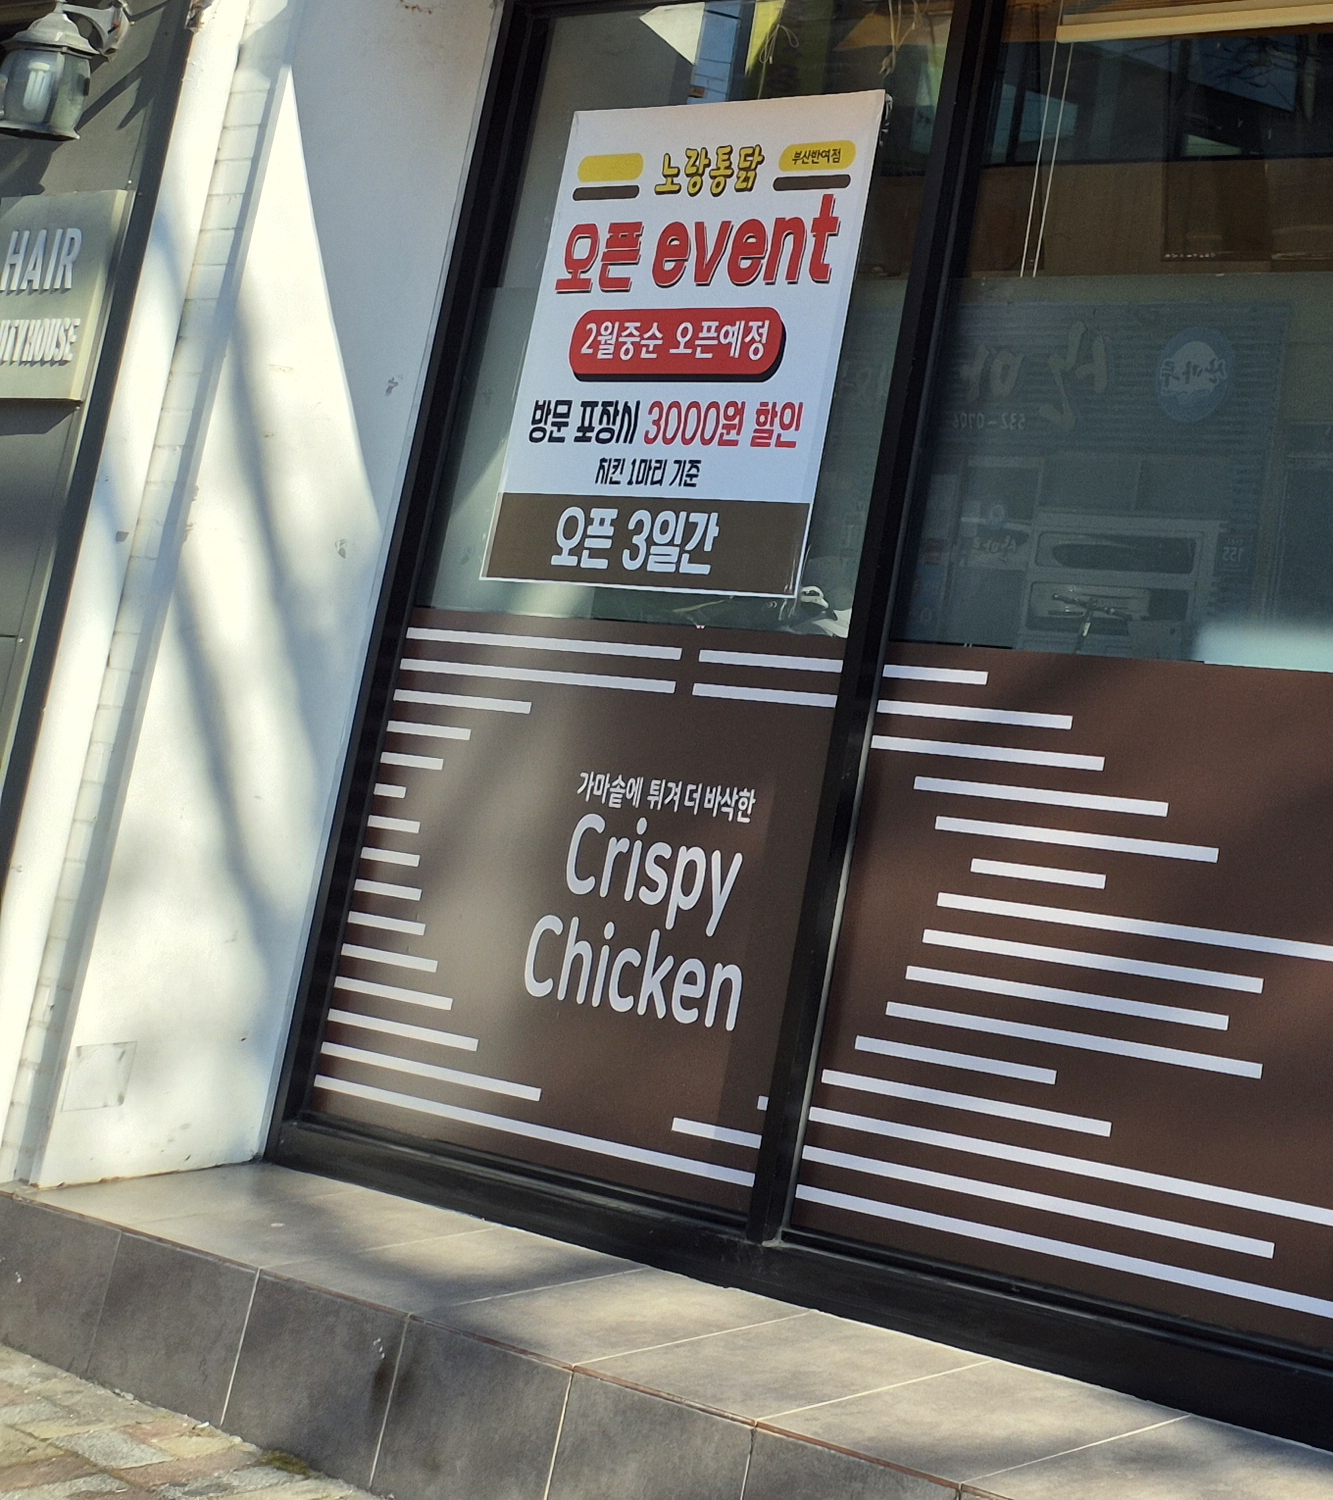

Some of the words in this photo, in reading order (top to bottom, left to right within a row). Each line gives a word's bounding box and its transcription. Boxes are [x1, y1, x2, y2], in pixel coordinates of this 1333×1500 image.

[654, 144, 765, 197] 노랑통닭
[791, 148, 842, 165] 부산반여점
[0, 227, 83, 291] HAIR
[554, 221, 644, 294] 오픈
[651, 194, 841, 287] event
[579, 320, 664, 361] 2월중순
[669, 318, 770, 362] 오픈예정
[527, 399, 573, 444] 방문
[573, 400, 639, 445] 포장시
[643, 400, 745, 448] 3000원
[750, 401, 804, 449] 할인
[594, 456, 628, 487] 치킨
[628, 458, 668, 488] 1마리
[671, 459, 702, 489] 기준
[550, 505, 619, 570] 오픈
[621, 509, 721, 576] 3일간
[577, 771, 644, 809] 가마솥에
[647, 779, 683, 813] 튀겨
[684, 783, 702, 815] 더
[703, 785, 756, 823] 바삭한
[566, 813, 743, 937] Crispy
[524, 914, 743, 1031] Chicken
